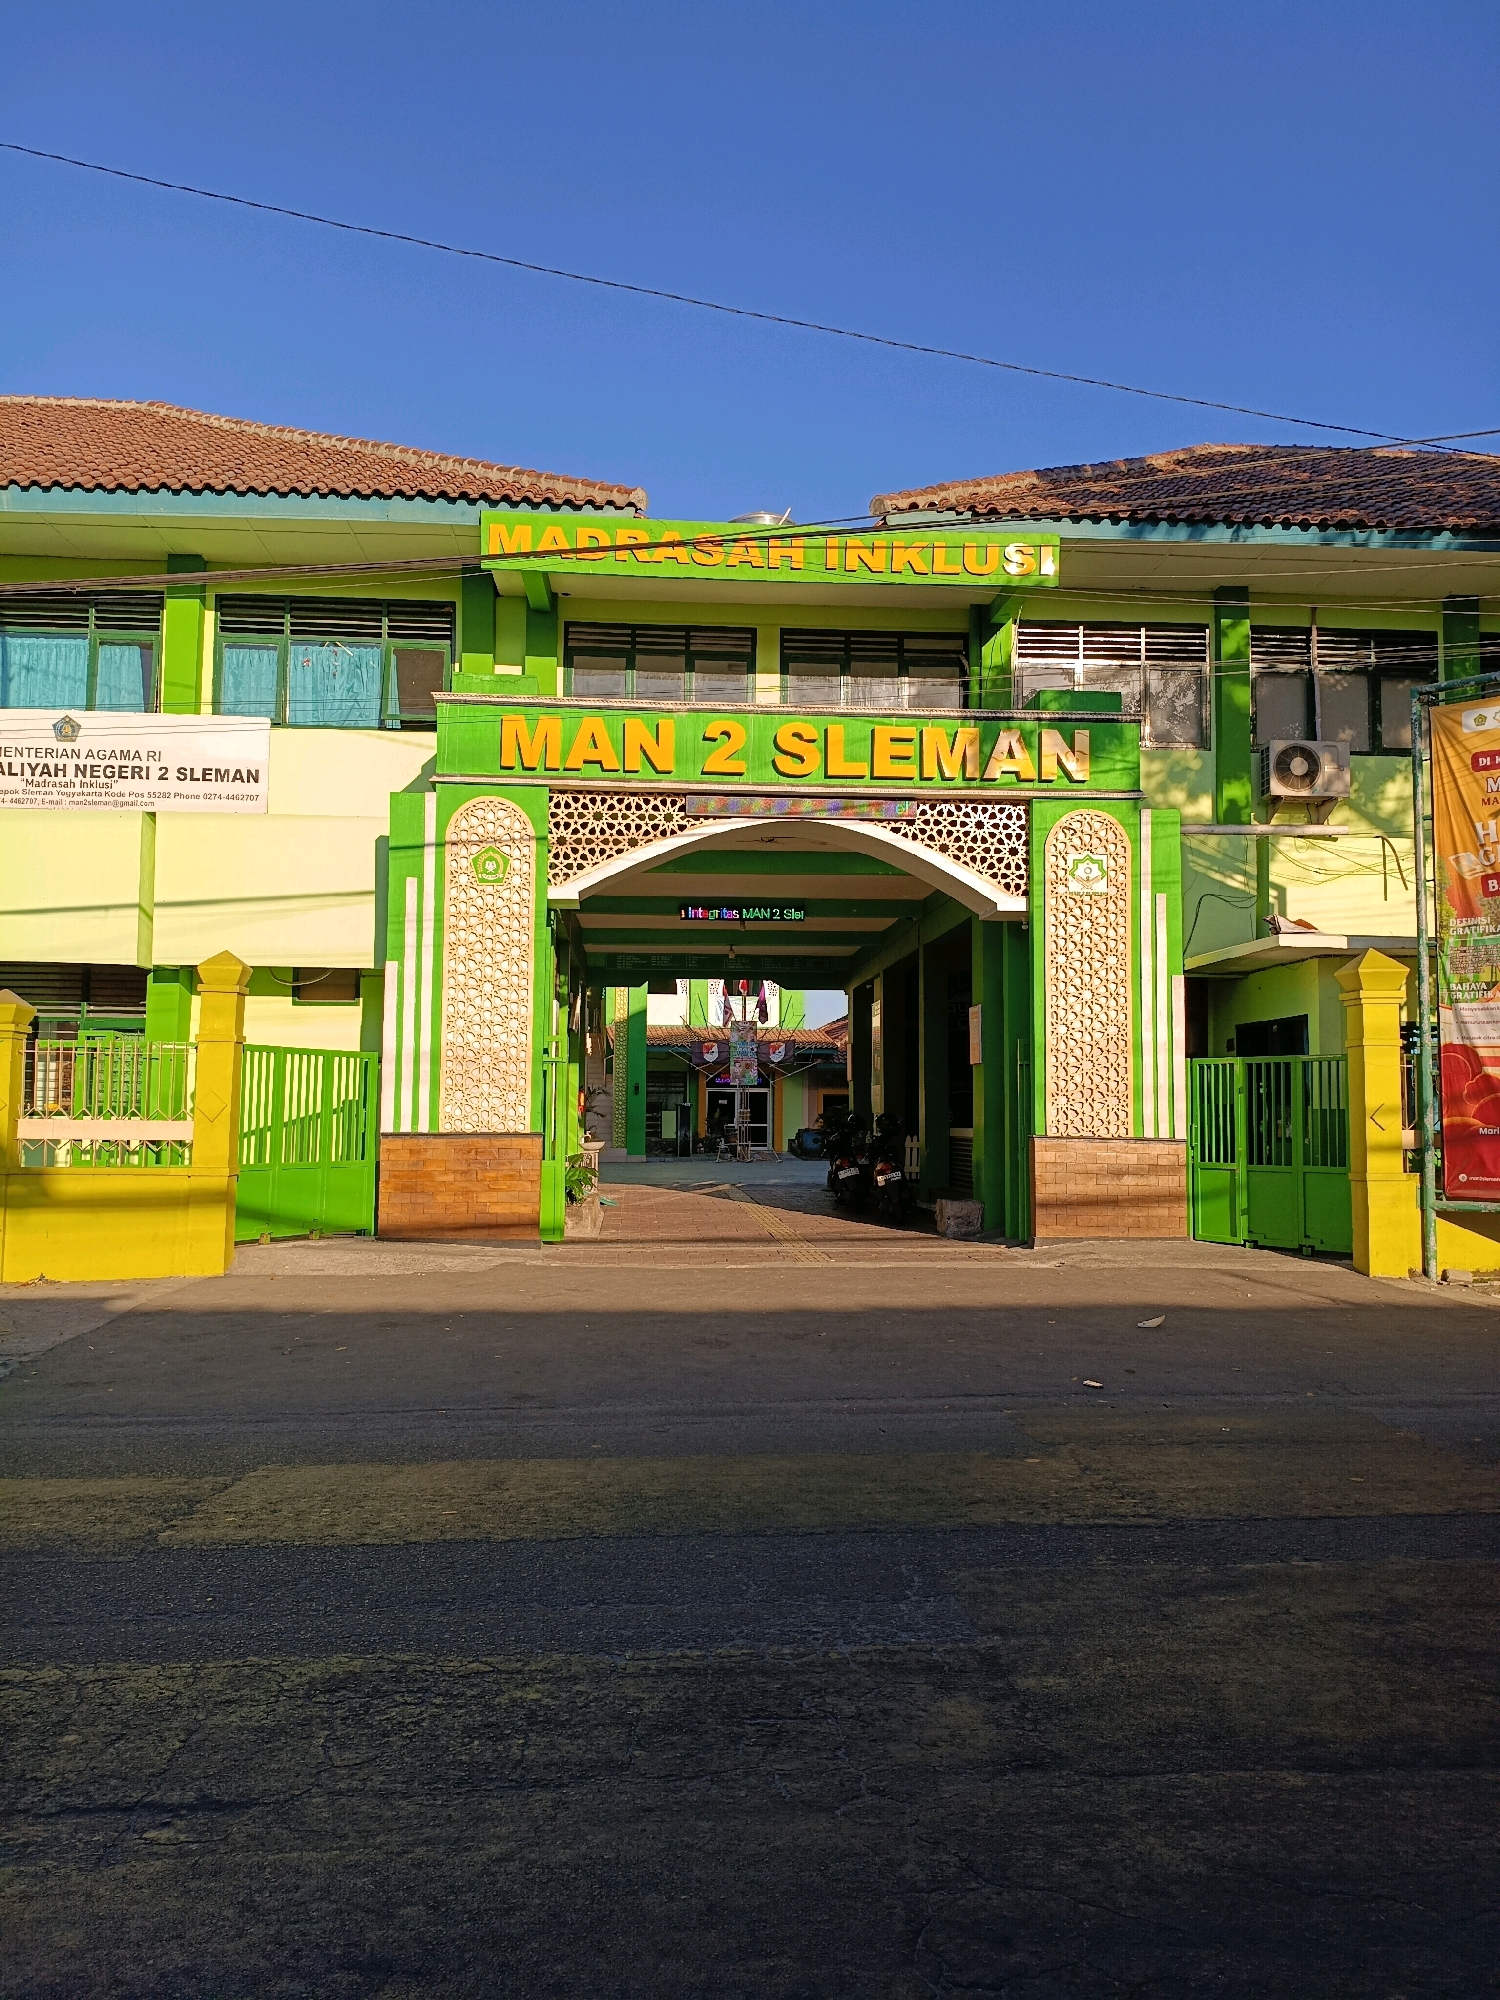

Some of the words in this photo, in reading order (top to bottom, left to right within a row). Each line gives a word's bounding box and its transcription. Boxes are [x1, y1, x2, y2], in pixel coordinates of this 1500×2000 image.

[488, 524, 806, 570] MADRASAH
[827, 537, 1055, 577] INKLUSI
[0, 746, 81, 760] ENTERIAN
[84, 749, 142, 761] AGAMA
[146, 750, 161, 762] RI
[500, 714, 676, 775] MAN
[701, 719, 747, 777] 2
[772, 723, 1091, 782] SLEMAN
[1478, 756, 1491, 767] DI
[74, 763, 150, 780] NEGERI
[157, 766, 169, 781] 2
[176, 766, 259, 783] SLEMAN
[21, 788, 54, 796] Sleman
[55, 789, 103, 798] Yogyakarta
[104, 790, 126, 798] Kode
[128, 791, 145, 799] Pos
[147, 791, 172, 799] 55282
[173, 792, 201, 800] Phone
[1488, 878, 1500, 892] B
[688, 906, 740, 921] Integritas
[742, 907, 770, 920] MAN
[772, 908, 781, 919] 2
[1449, 916, 1491, 927] DEFINISI
[1450, 982, 1488, 991] BAHAYA
[1479, 1126, 1499, 1134] Mari
